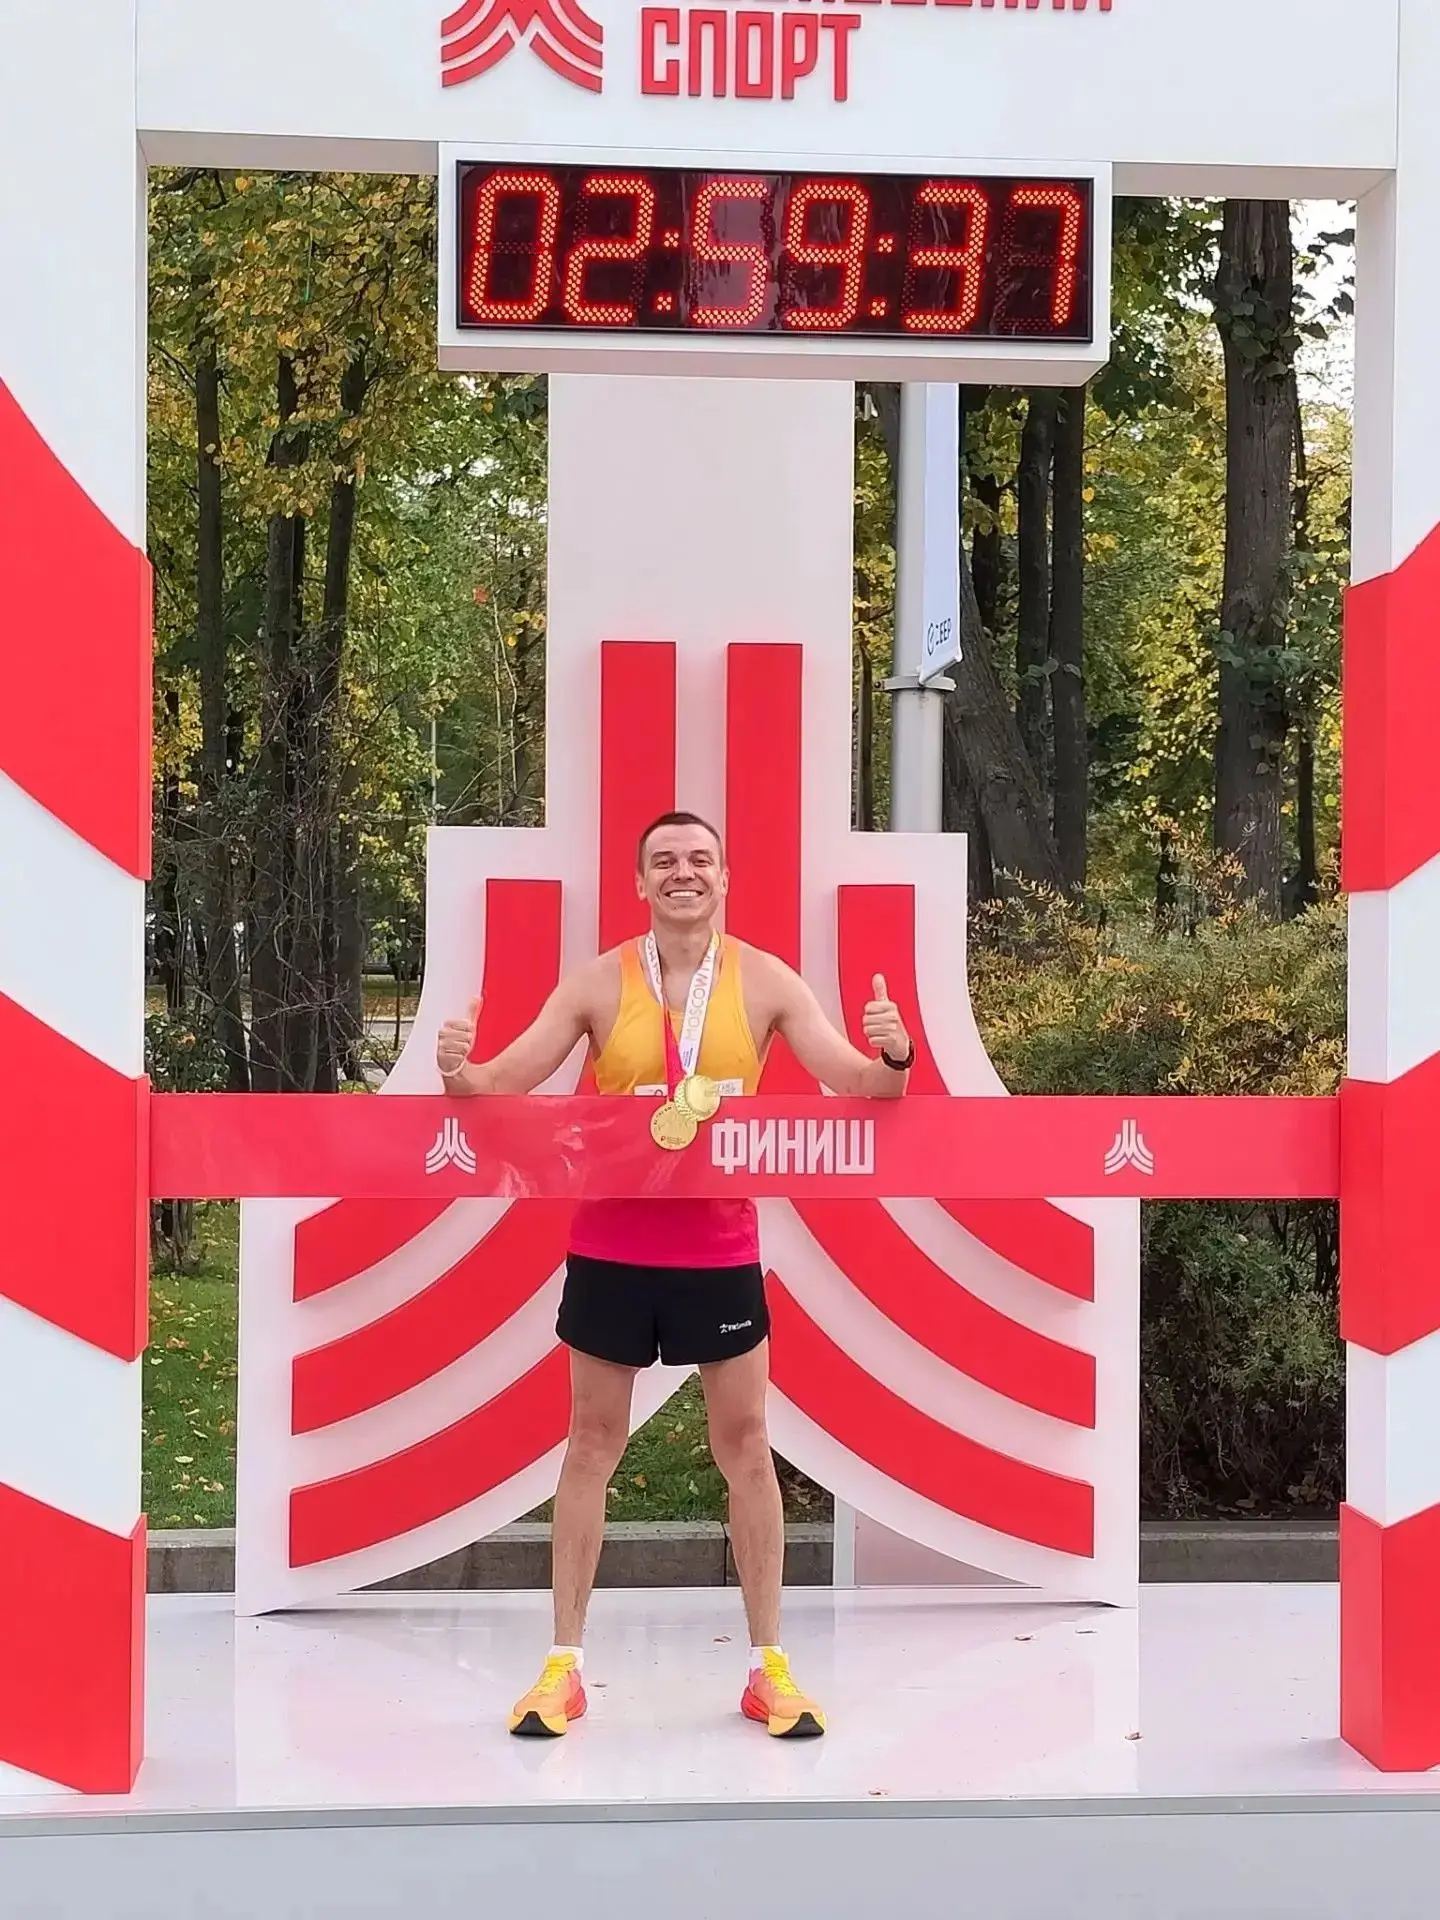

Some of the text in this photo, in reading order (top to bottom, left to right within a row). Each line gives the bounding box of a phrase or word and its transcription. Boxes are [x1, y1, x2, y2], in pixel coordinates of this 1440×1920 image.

[641, 8, 861, 101] СПОРТ
[468, 175, 1081, 331] 02:59:37
[684, 970, 709, 1041] MOSCOW
[711, 1119, 875, 1175] ФИНИШ
